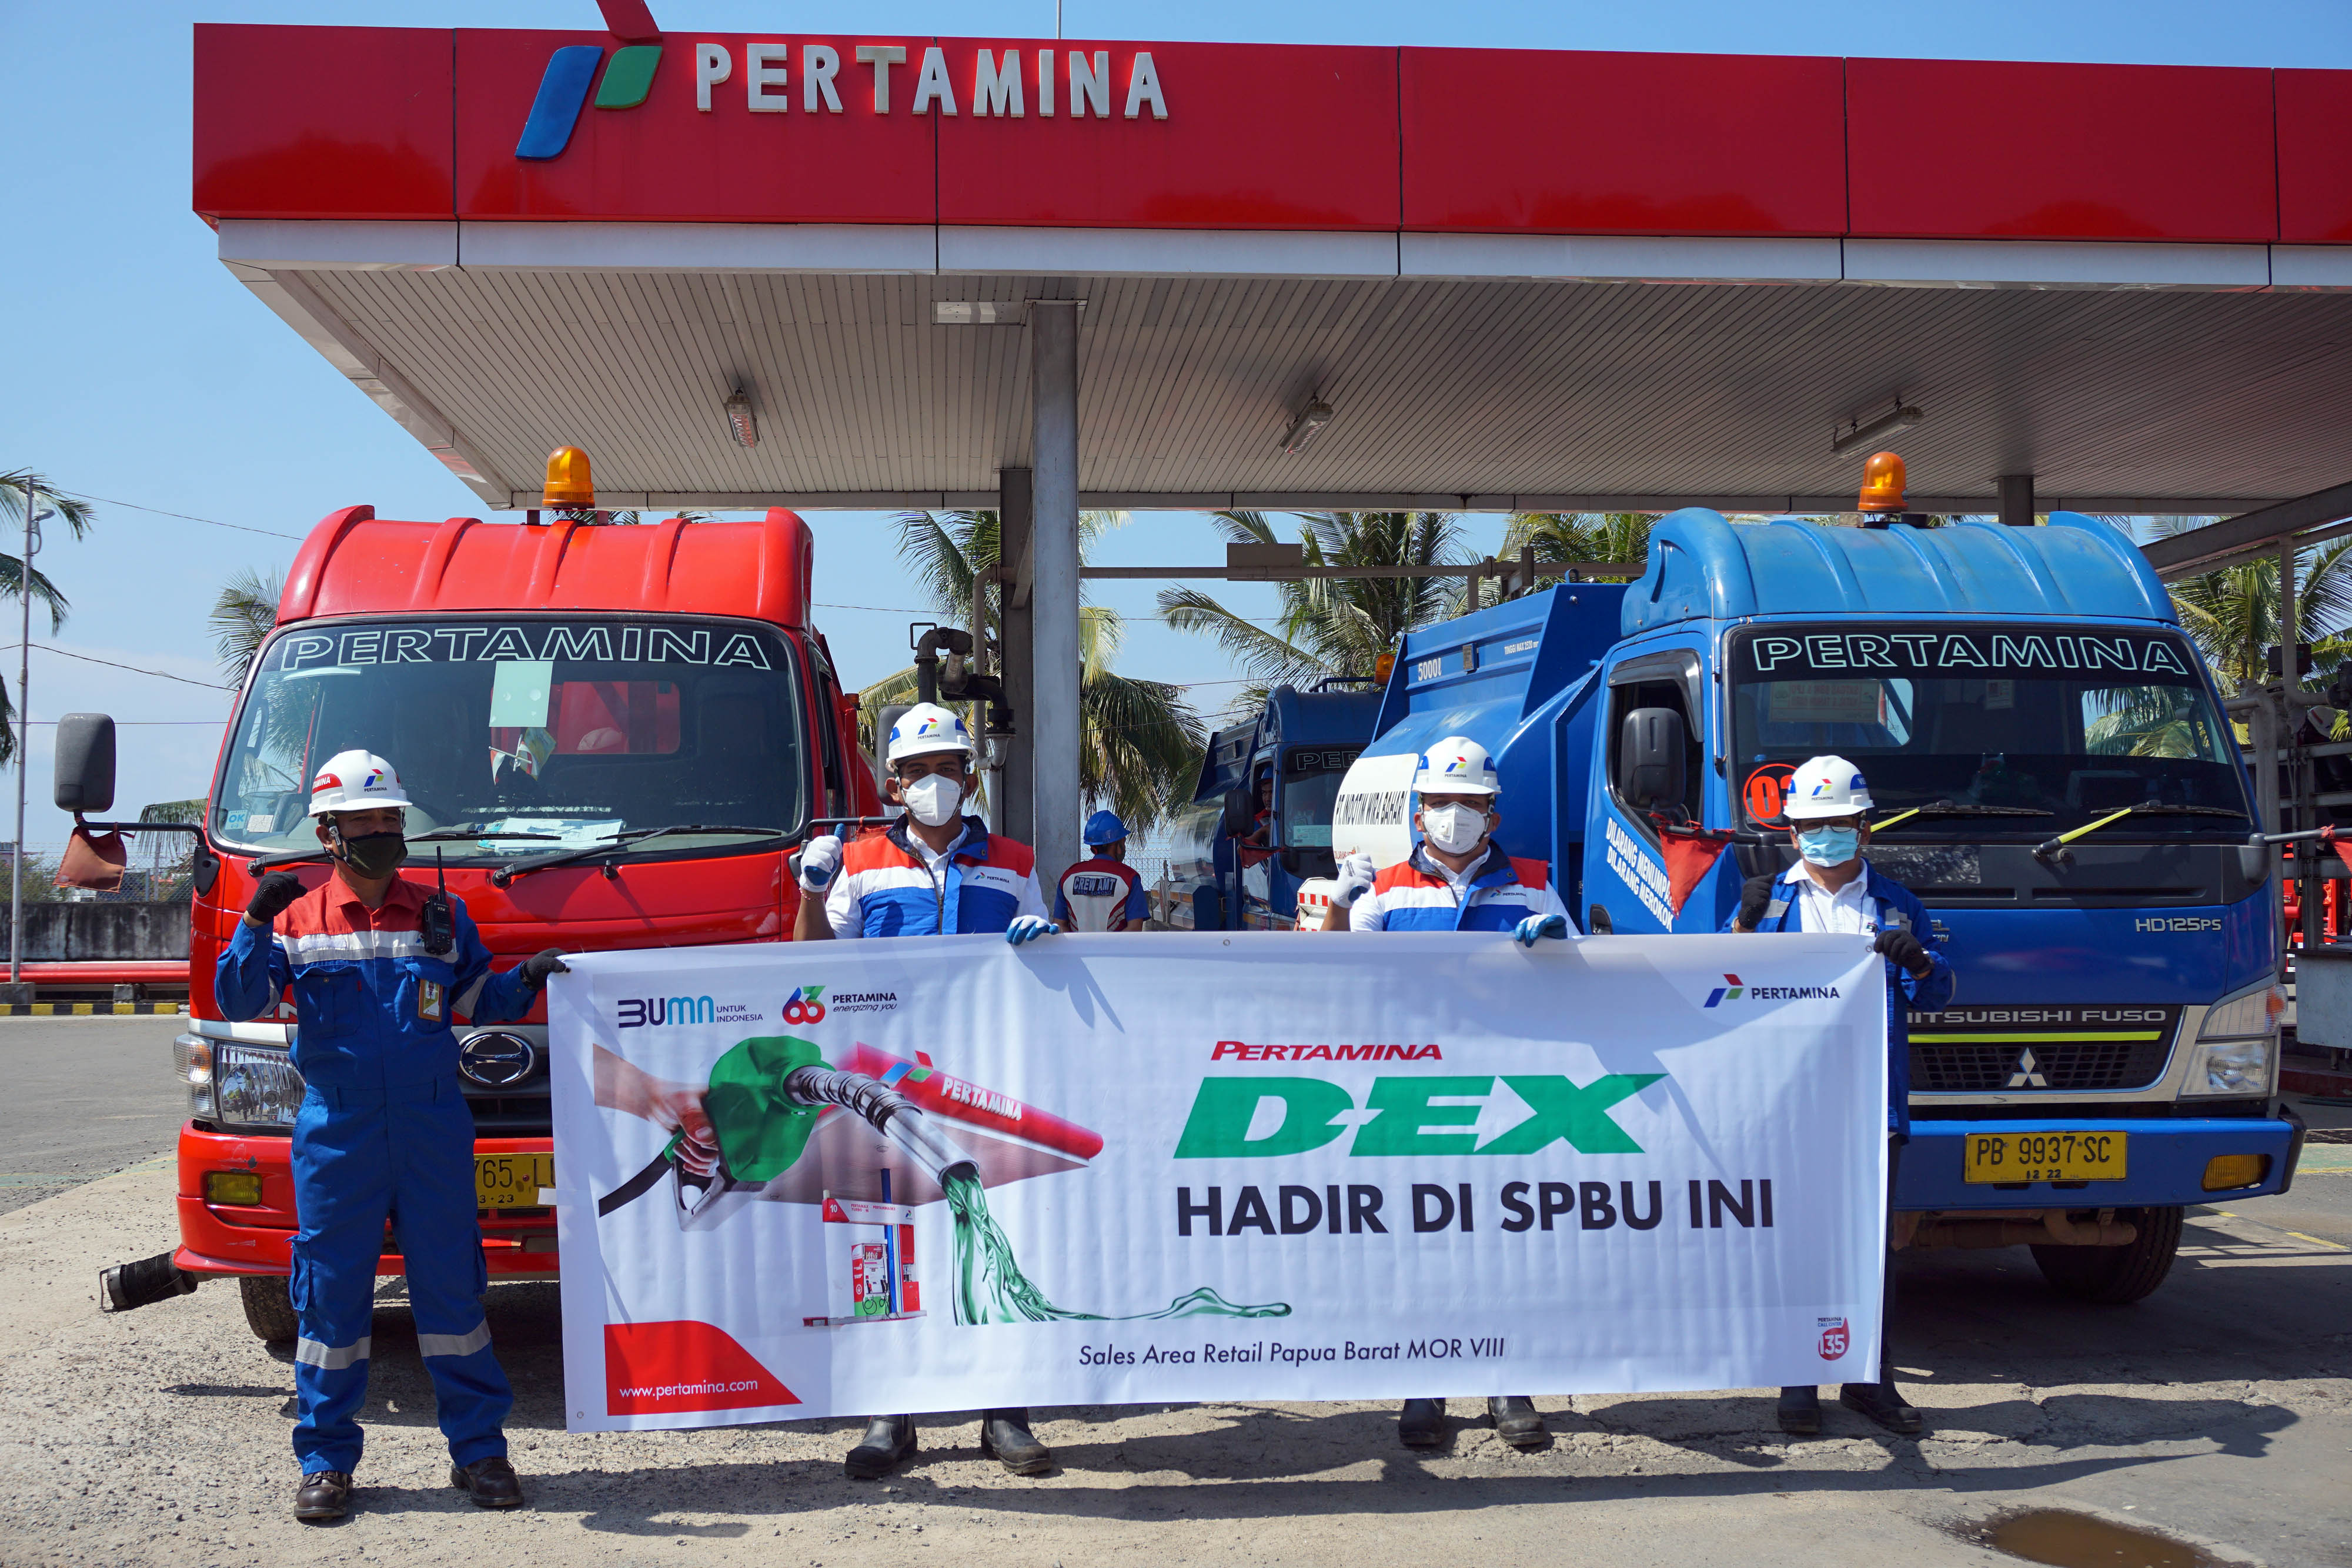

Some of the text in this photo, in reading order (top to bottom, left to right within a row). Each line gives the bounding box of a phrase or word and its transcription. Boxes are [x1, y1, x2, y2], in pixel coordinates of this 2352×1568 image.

[696, 43, 1168, 119] PERTAMINA
[280, 627, 771, 671] PERTAMINA
[1752, 634, 2189, 675] PERTAMINA
[1297, 751, 1361, 770] PER
[1380, 790, 1408, 825] BAHARI
[229, 814, 245, 823] OK
[1606, 817, 1675, 911] DILARANG MENUMPA
[1074, 877, 1115, 891] CREW AMT
[1607, 845, 1674, 934] DILARANG MEROKOK
[2135, 917, 2221, 932] HD125PS
[833, 992, 897, 1004] PERTAMINA
[1751, 987, 1840, 999] PERTAMINA
[617, 995, 714, 1028] BUMN
[717, 1005, 746, 1013] UNTUK
[717, 1013, 763, 1023] INDONESIA
[833, 1002, 897, 1014] energizing you
[2082, 1010, 2166, 1022] FUSO
[1211, 1041, 1442, 1061] PERTAMINA
[941, 1076, 1022, 1121] PERTAMINA
[1173, 1073, 1669, 1158] DEX
[1977, 1136, 2111, 1165] PB 9937 SC
[2026, 1169, 2062, 1179] 12 22
[830, 1204, 838, 1213] 10
[1177, 1178, 1773, 1236] HADIR DI SPBU INI
[1079, 1338, 1505, 1368] Sales Area Retail Papua Barat MOR VIII
[1820, 1334, 1845, 1355] 135
[619, 1379, 758, 1400] www.pertamina.com
